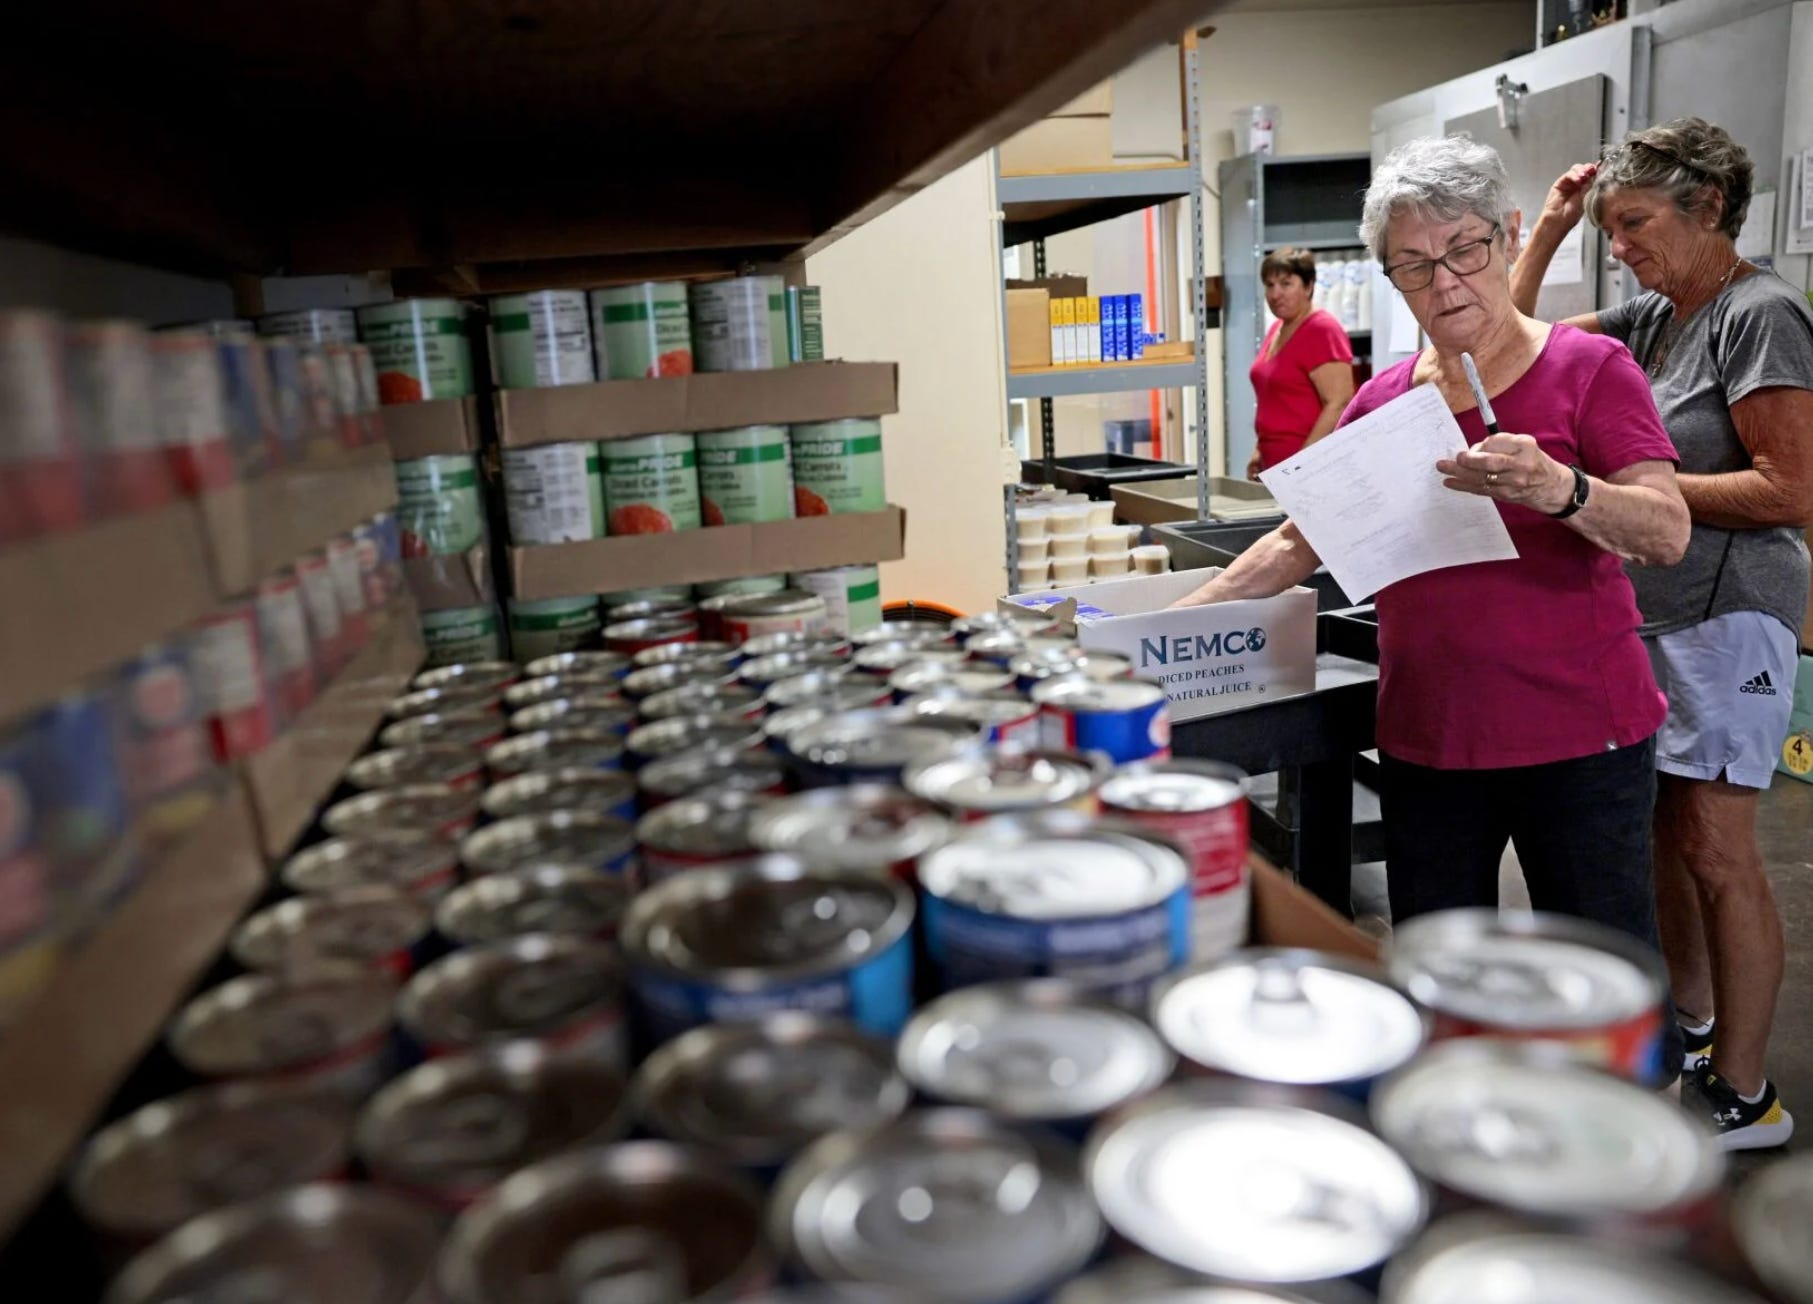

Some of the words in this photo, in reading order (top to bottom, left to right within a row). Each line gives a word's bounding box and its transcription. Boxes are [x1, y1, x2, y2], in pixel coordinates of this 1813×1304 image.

[800, 441, 844, 456] PRIDE
[638, 454, 683, 471] PRIDE
[641, 474, 682, 488] Caots
[1140, 626, 1267, 668] NEMCO
[1158, 671, 1193, 684] DICED
[1195, 664, 1245, 680] PEACHES
[1167, 686, 1218, 702] NATURAL
[1220, 681, 1252, 695] JUICE
[1739, 685, 1777, 696] adidas
[1792, 739, 1803, 756] 4
